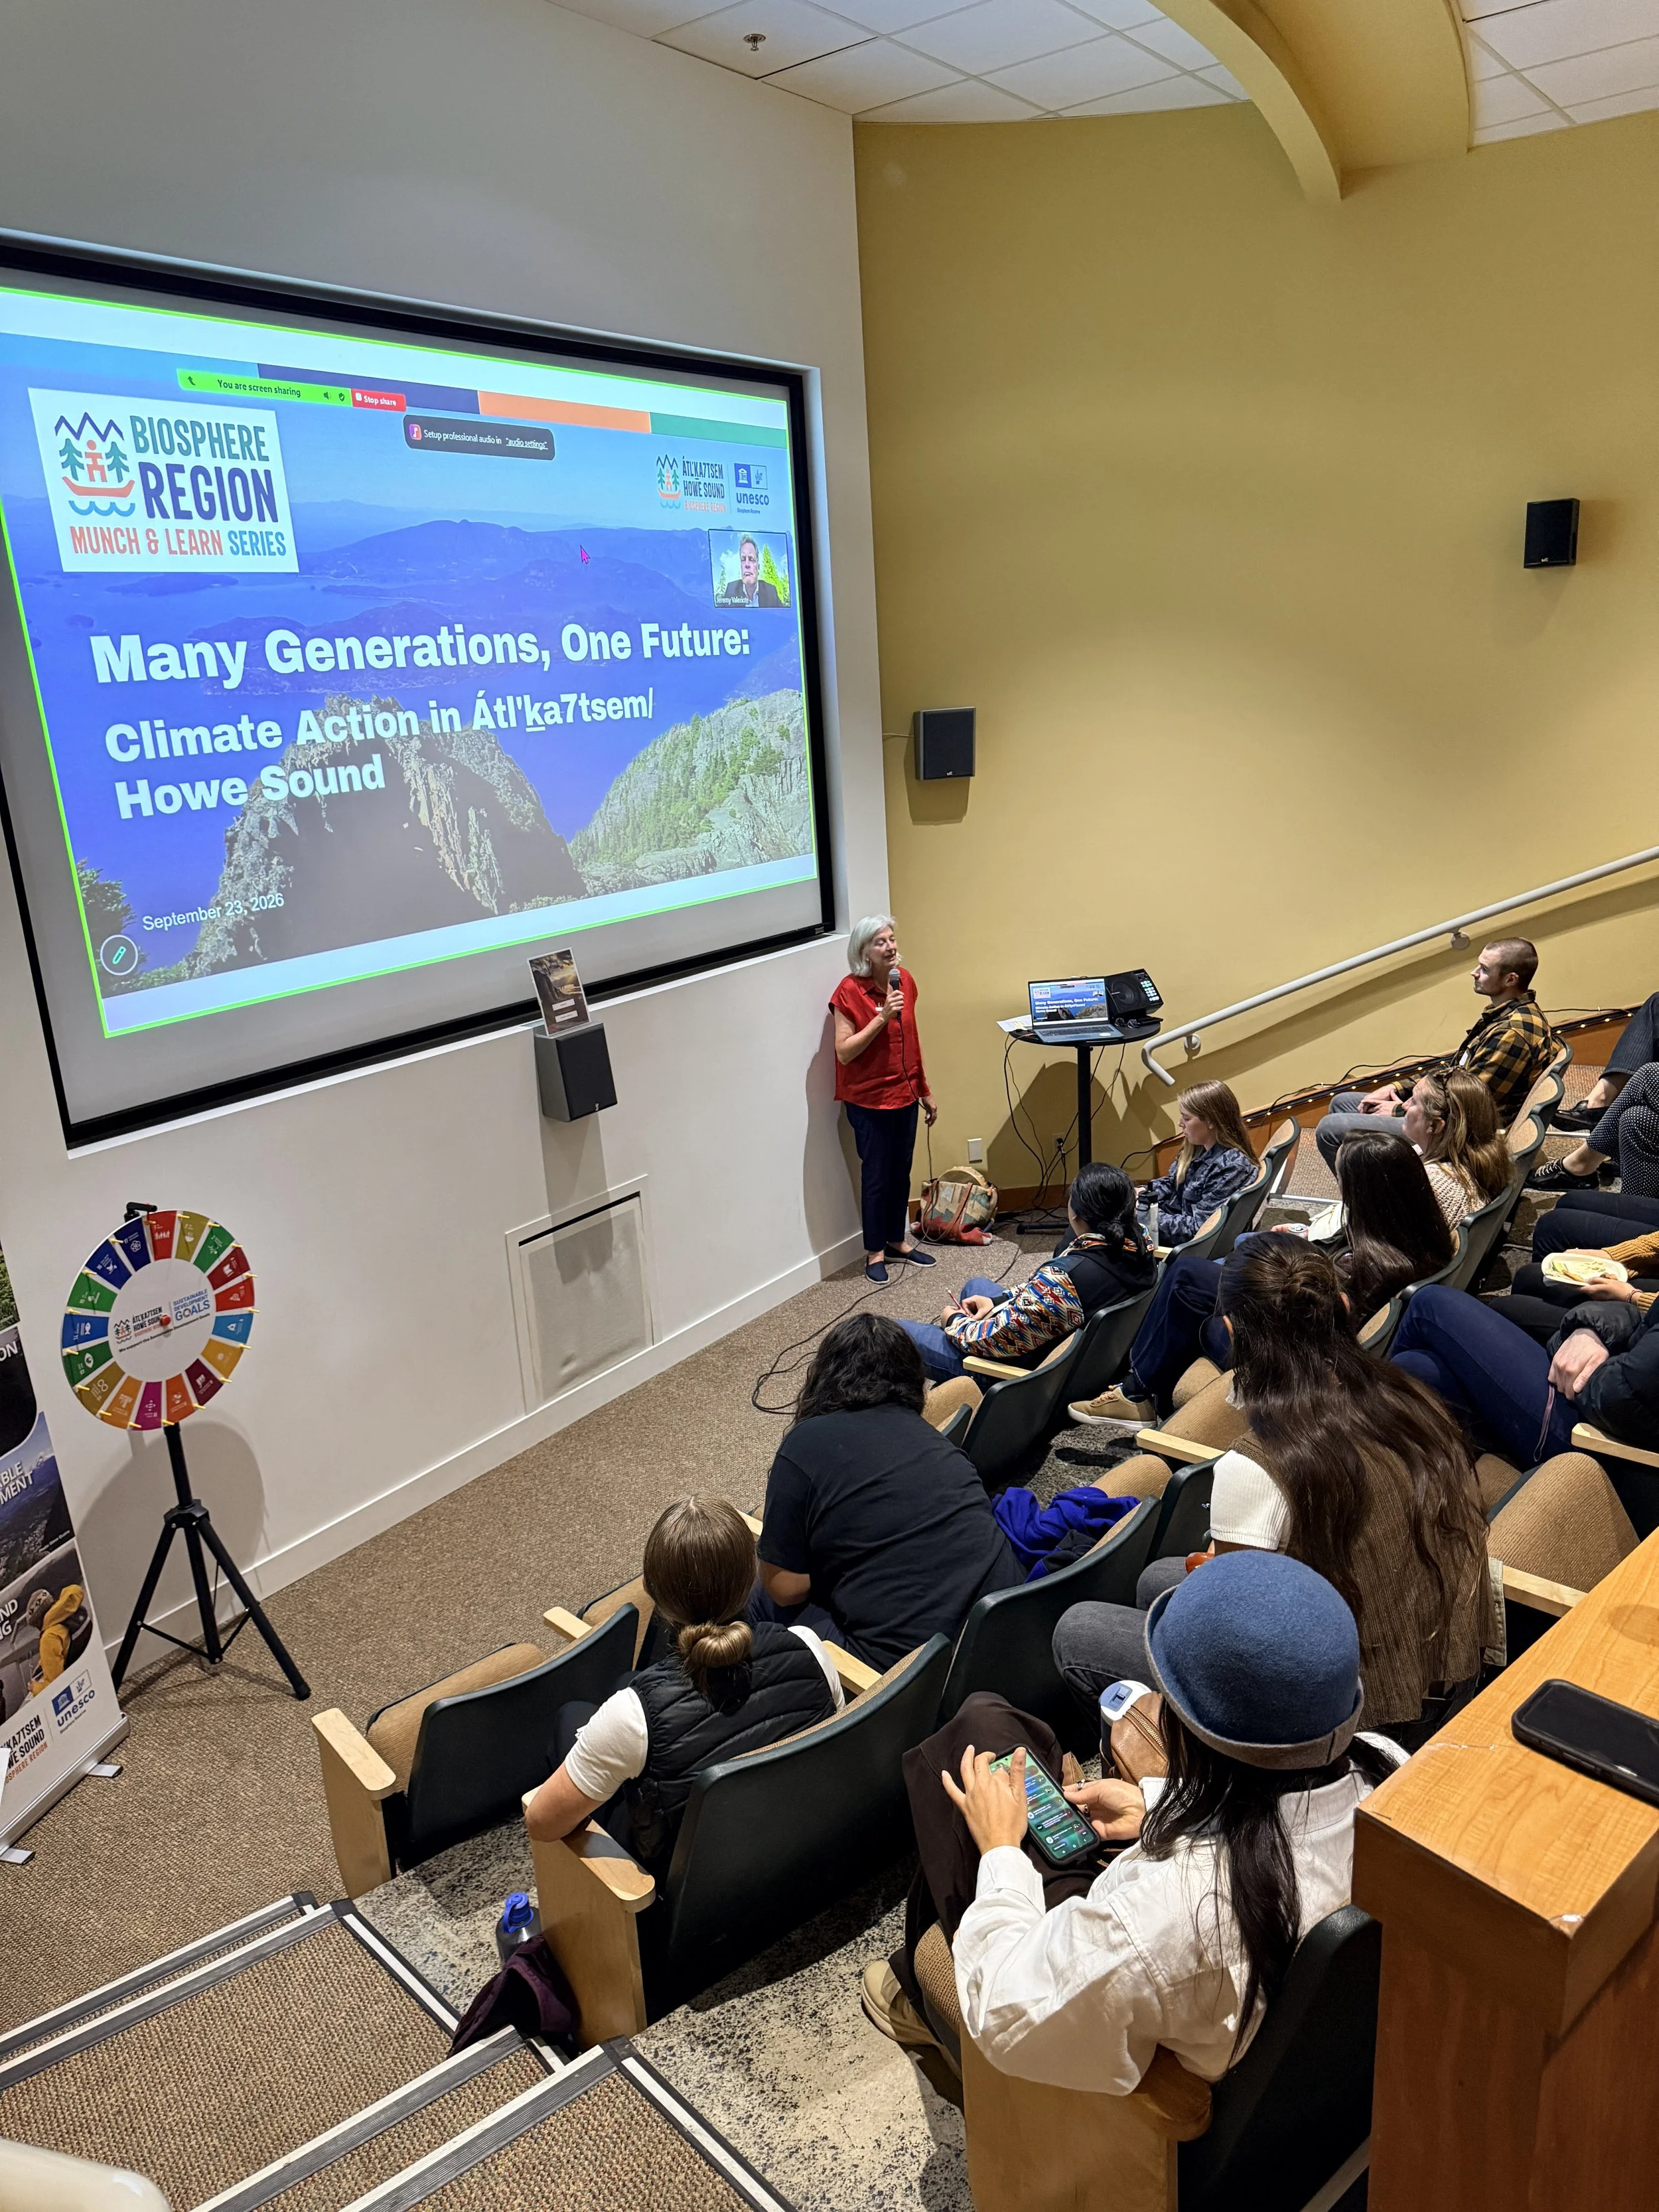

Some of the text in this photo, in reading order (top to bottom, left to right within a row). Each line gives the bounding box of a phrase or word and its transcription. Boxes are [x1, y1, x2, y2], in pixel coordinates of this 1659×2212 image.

[217, 379, 232, 390] You
[248, 384, 273, 394] screen
[274, 386, 301, 398] sharing
[364, 396, 397, 406] Stop share
[129, 415, 269, 462] BIOSPHERE
[423, 429, 442, 441] Setup
[443, 431, 478, 443] professional
[138, 461, 279, 523] REGION
[683, 480, 725, 499] HOWE SOUND
[736, 492, 769, 506] unesco
[69, 526, 287, 556] MUNCH & LEARN SERIES
[90, 622, 751, 690] Many Generations, One Future:
[105, 714, 283, 763] Climate
[297, 704, 420, 746] Action
[428, 699, 461, 734] in
[114, 753, 386, 820] Howe Sound
[143, 906, 222, 931] September
[250, 893, 285, 911] 2026
[175, 1300, 210, 1321] GOALS
[133, 1321, 147, 1331] HOWE
[0, 1461, 23, 1487] BLE
[57, 1690, 96, 1727] unesco
[19, 1728, 45, 1758] SOUND
[5, 1741, 48, 1784] OSPHERE REGION
